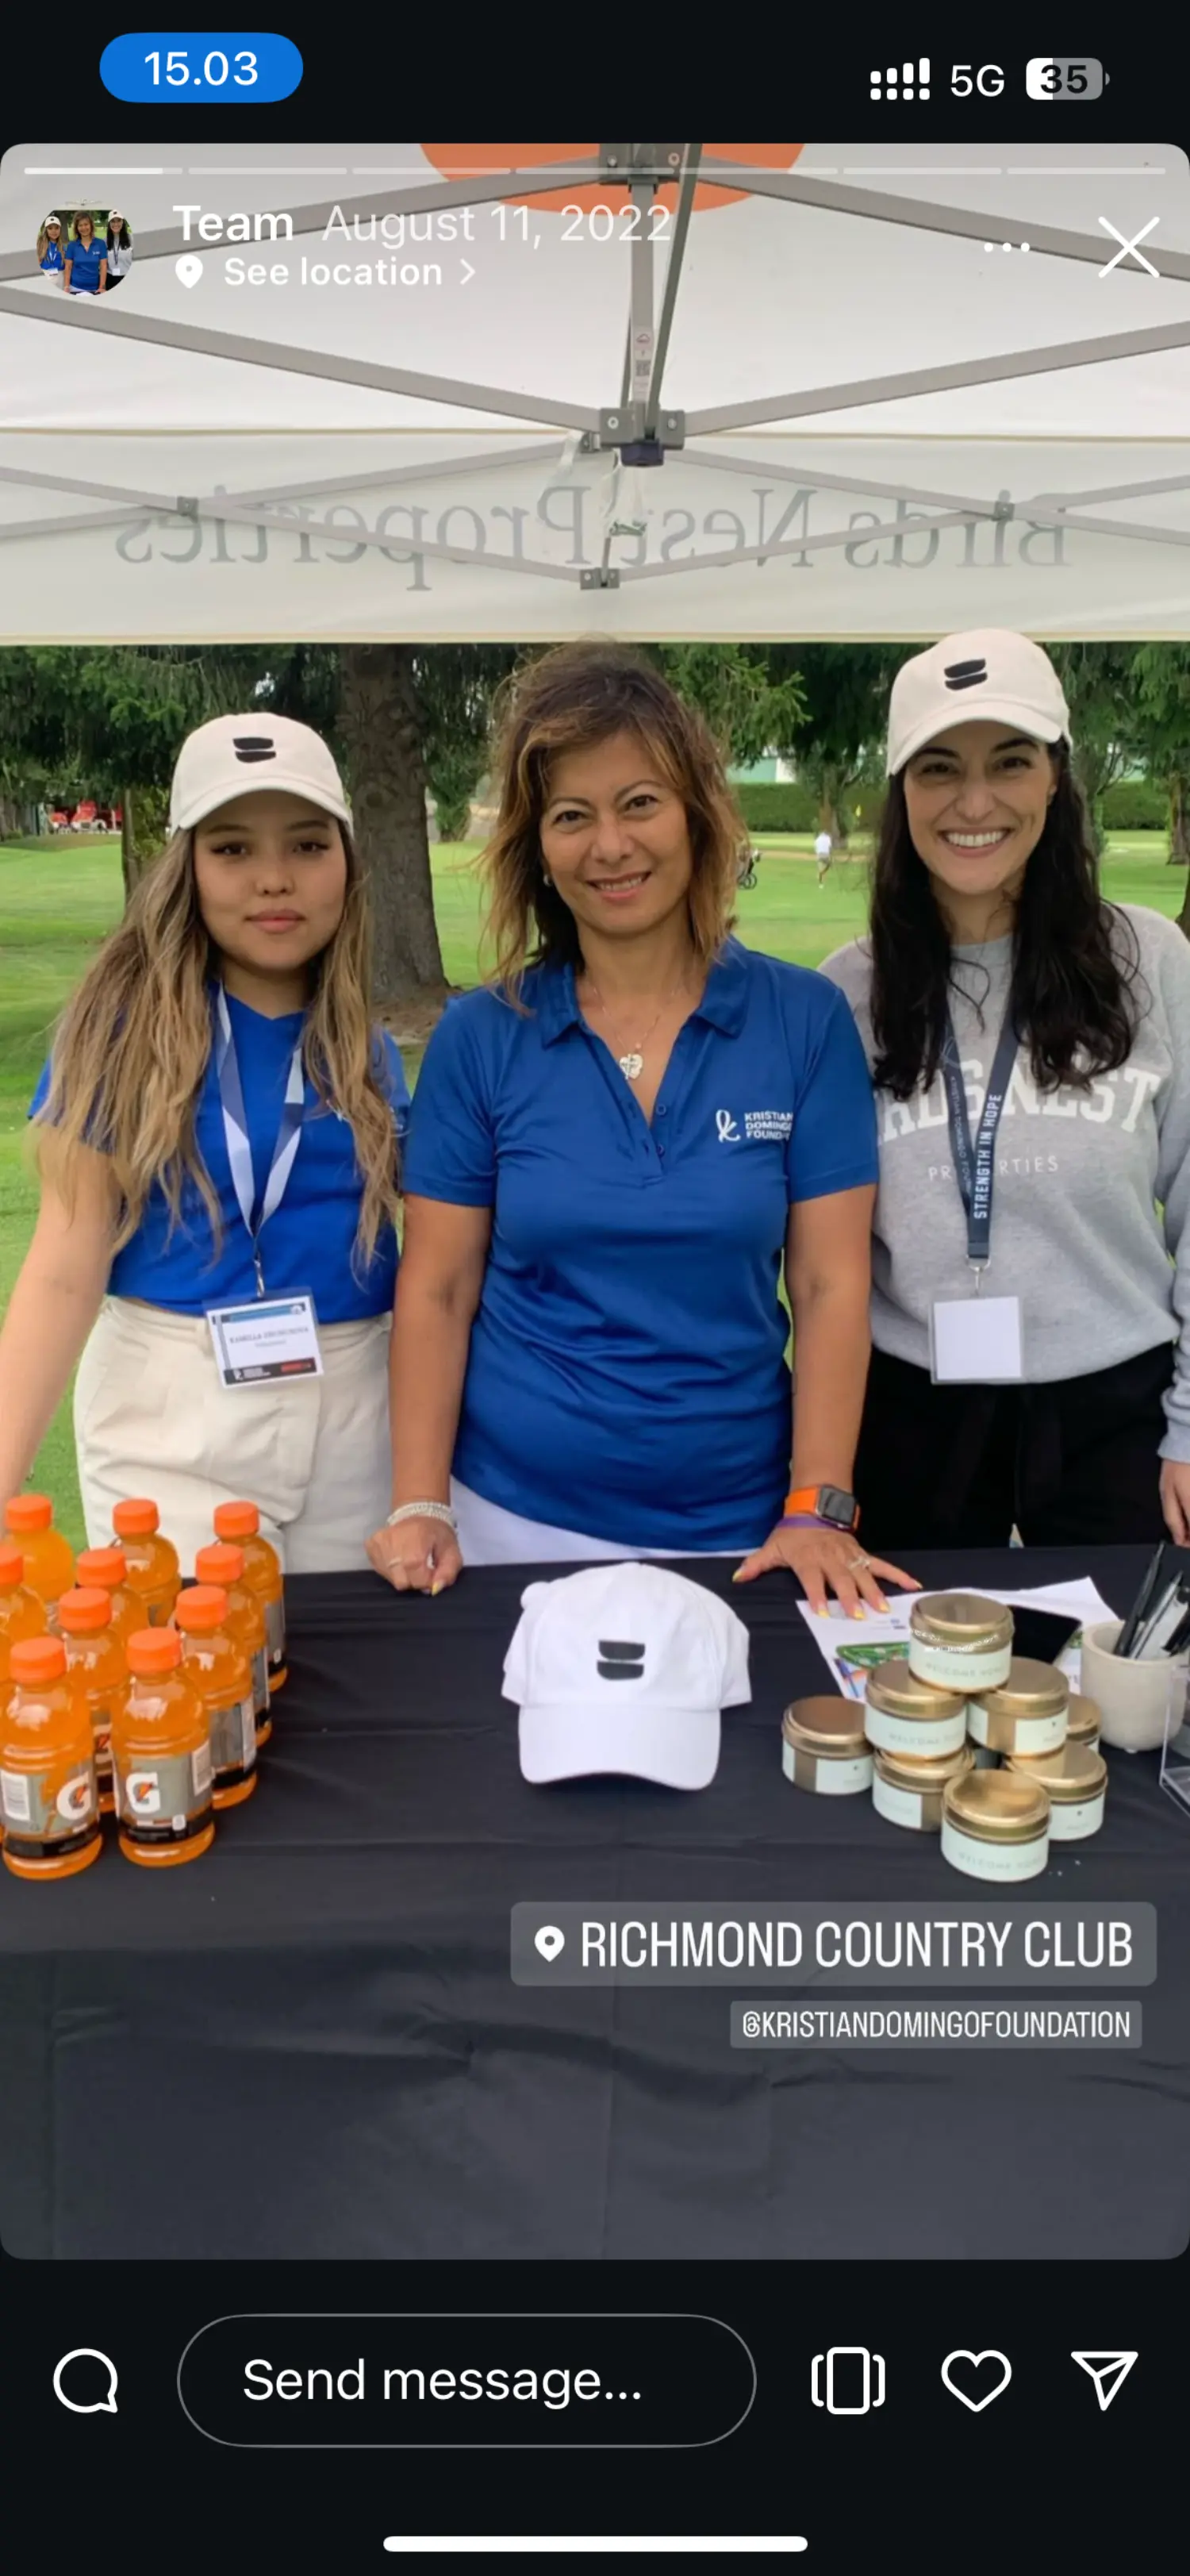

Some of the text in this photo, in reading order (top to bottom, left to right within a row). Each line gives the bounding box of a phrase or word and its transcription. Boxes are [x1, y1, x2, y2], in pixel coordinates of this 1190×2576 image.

[973, 1094, 1003, 1220] STRENGTH IN HOPE
[56, 1771, 92, 1821] G
[125, 1771, 161, 1814] G
